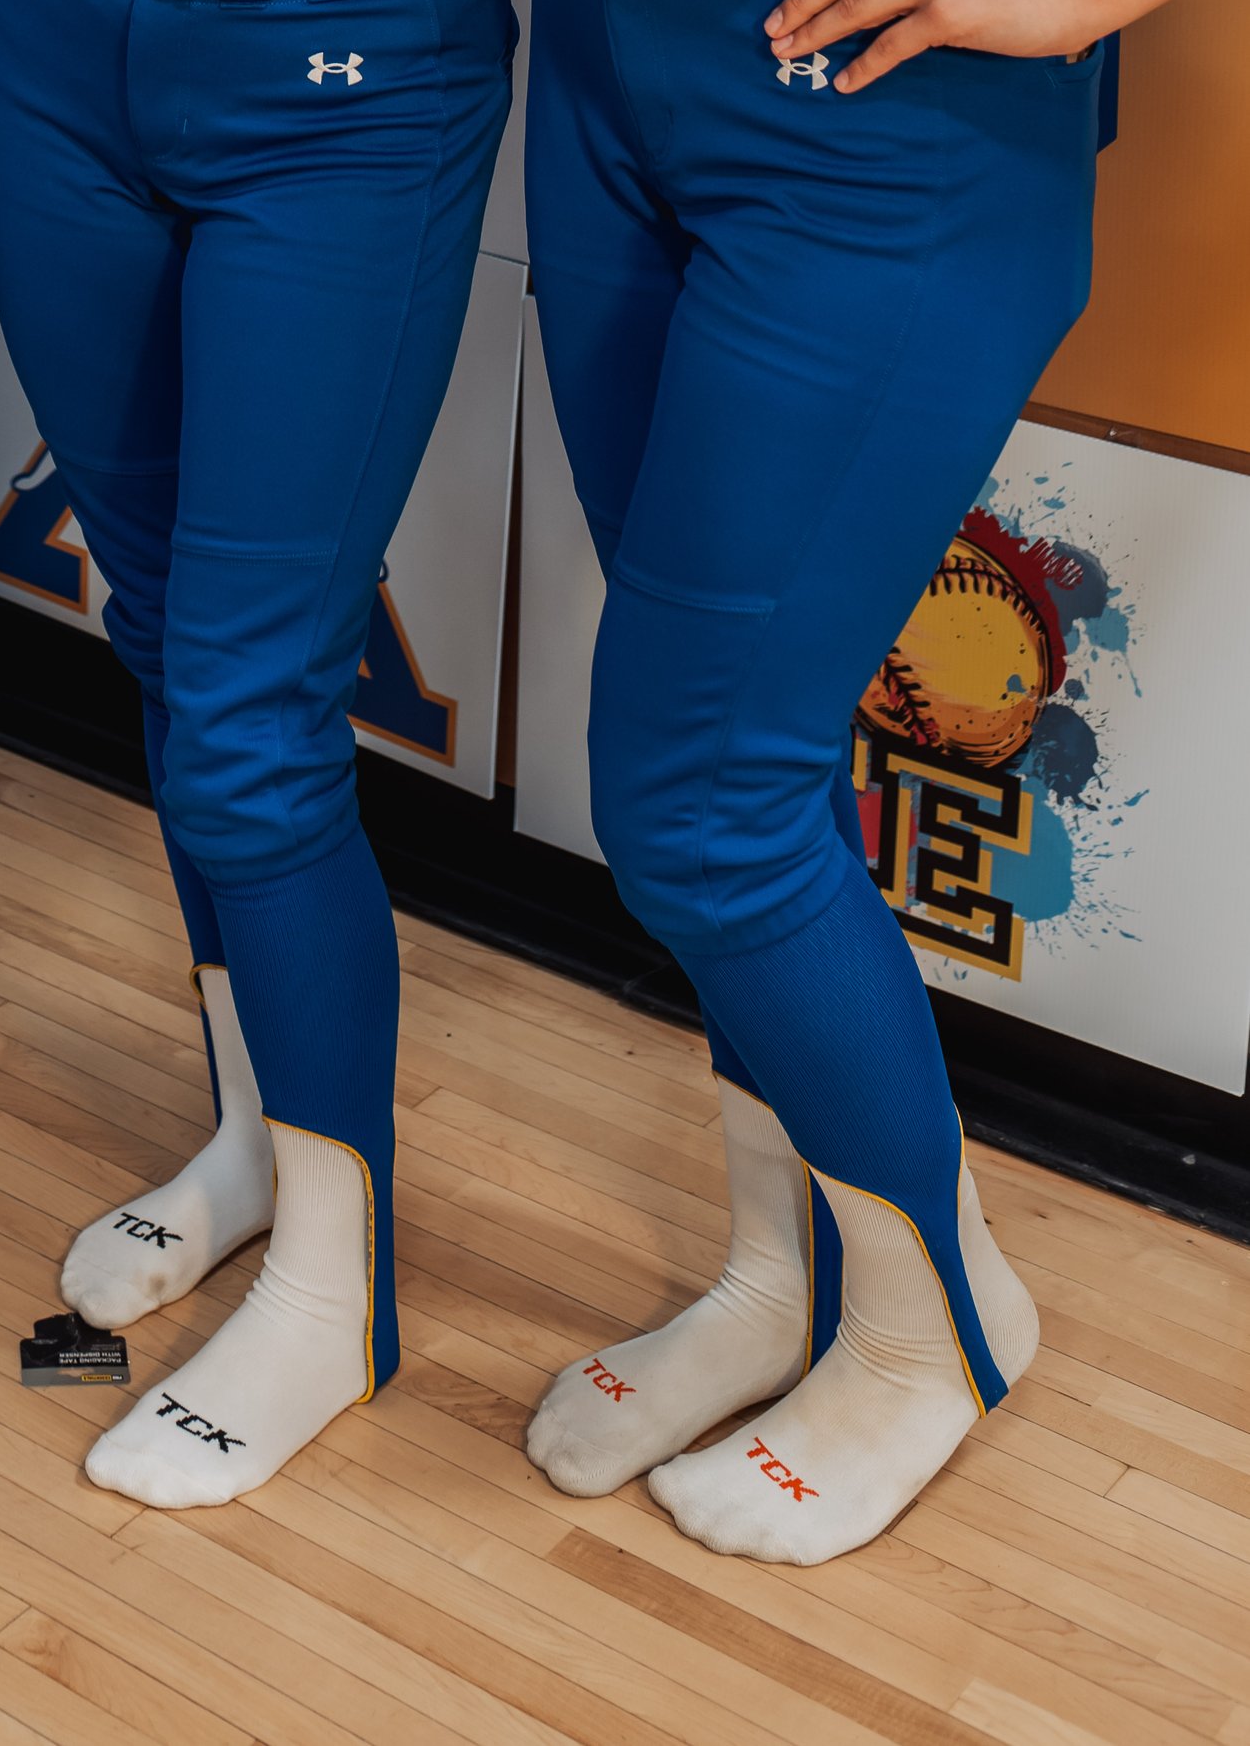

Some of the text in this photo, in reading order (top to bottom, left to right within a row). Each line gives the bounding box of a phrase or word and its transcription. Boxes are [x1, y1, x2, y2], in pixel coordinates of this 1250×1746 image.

[109, 1212, 183, 1250] TCK
[578, 1357, 637, 1404] TCK
[157, 1392, 247, 1454] TCK
[745, 1436, 819, 1503] TCK
